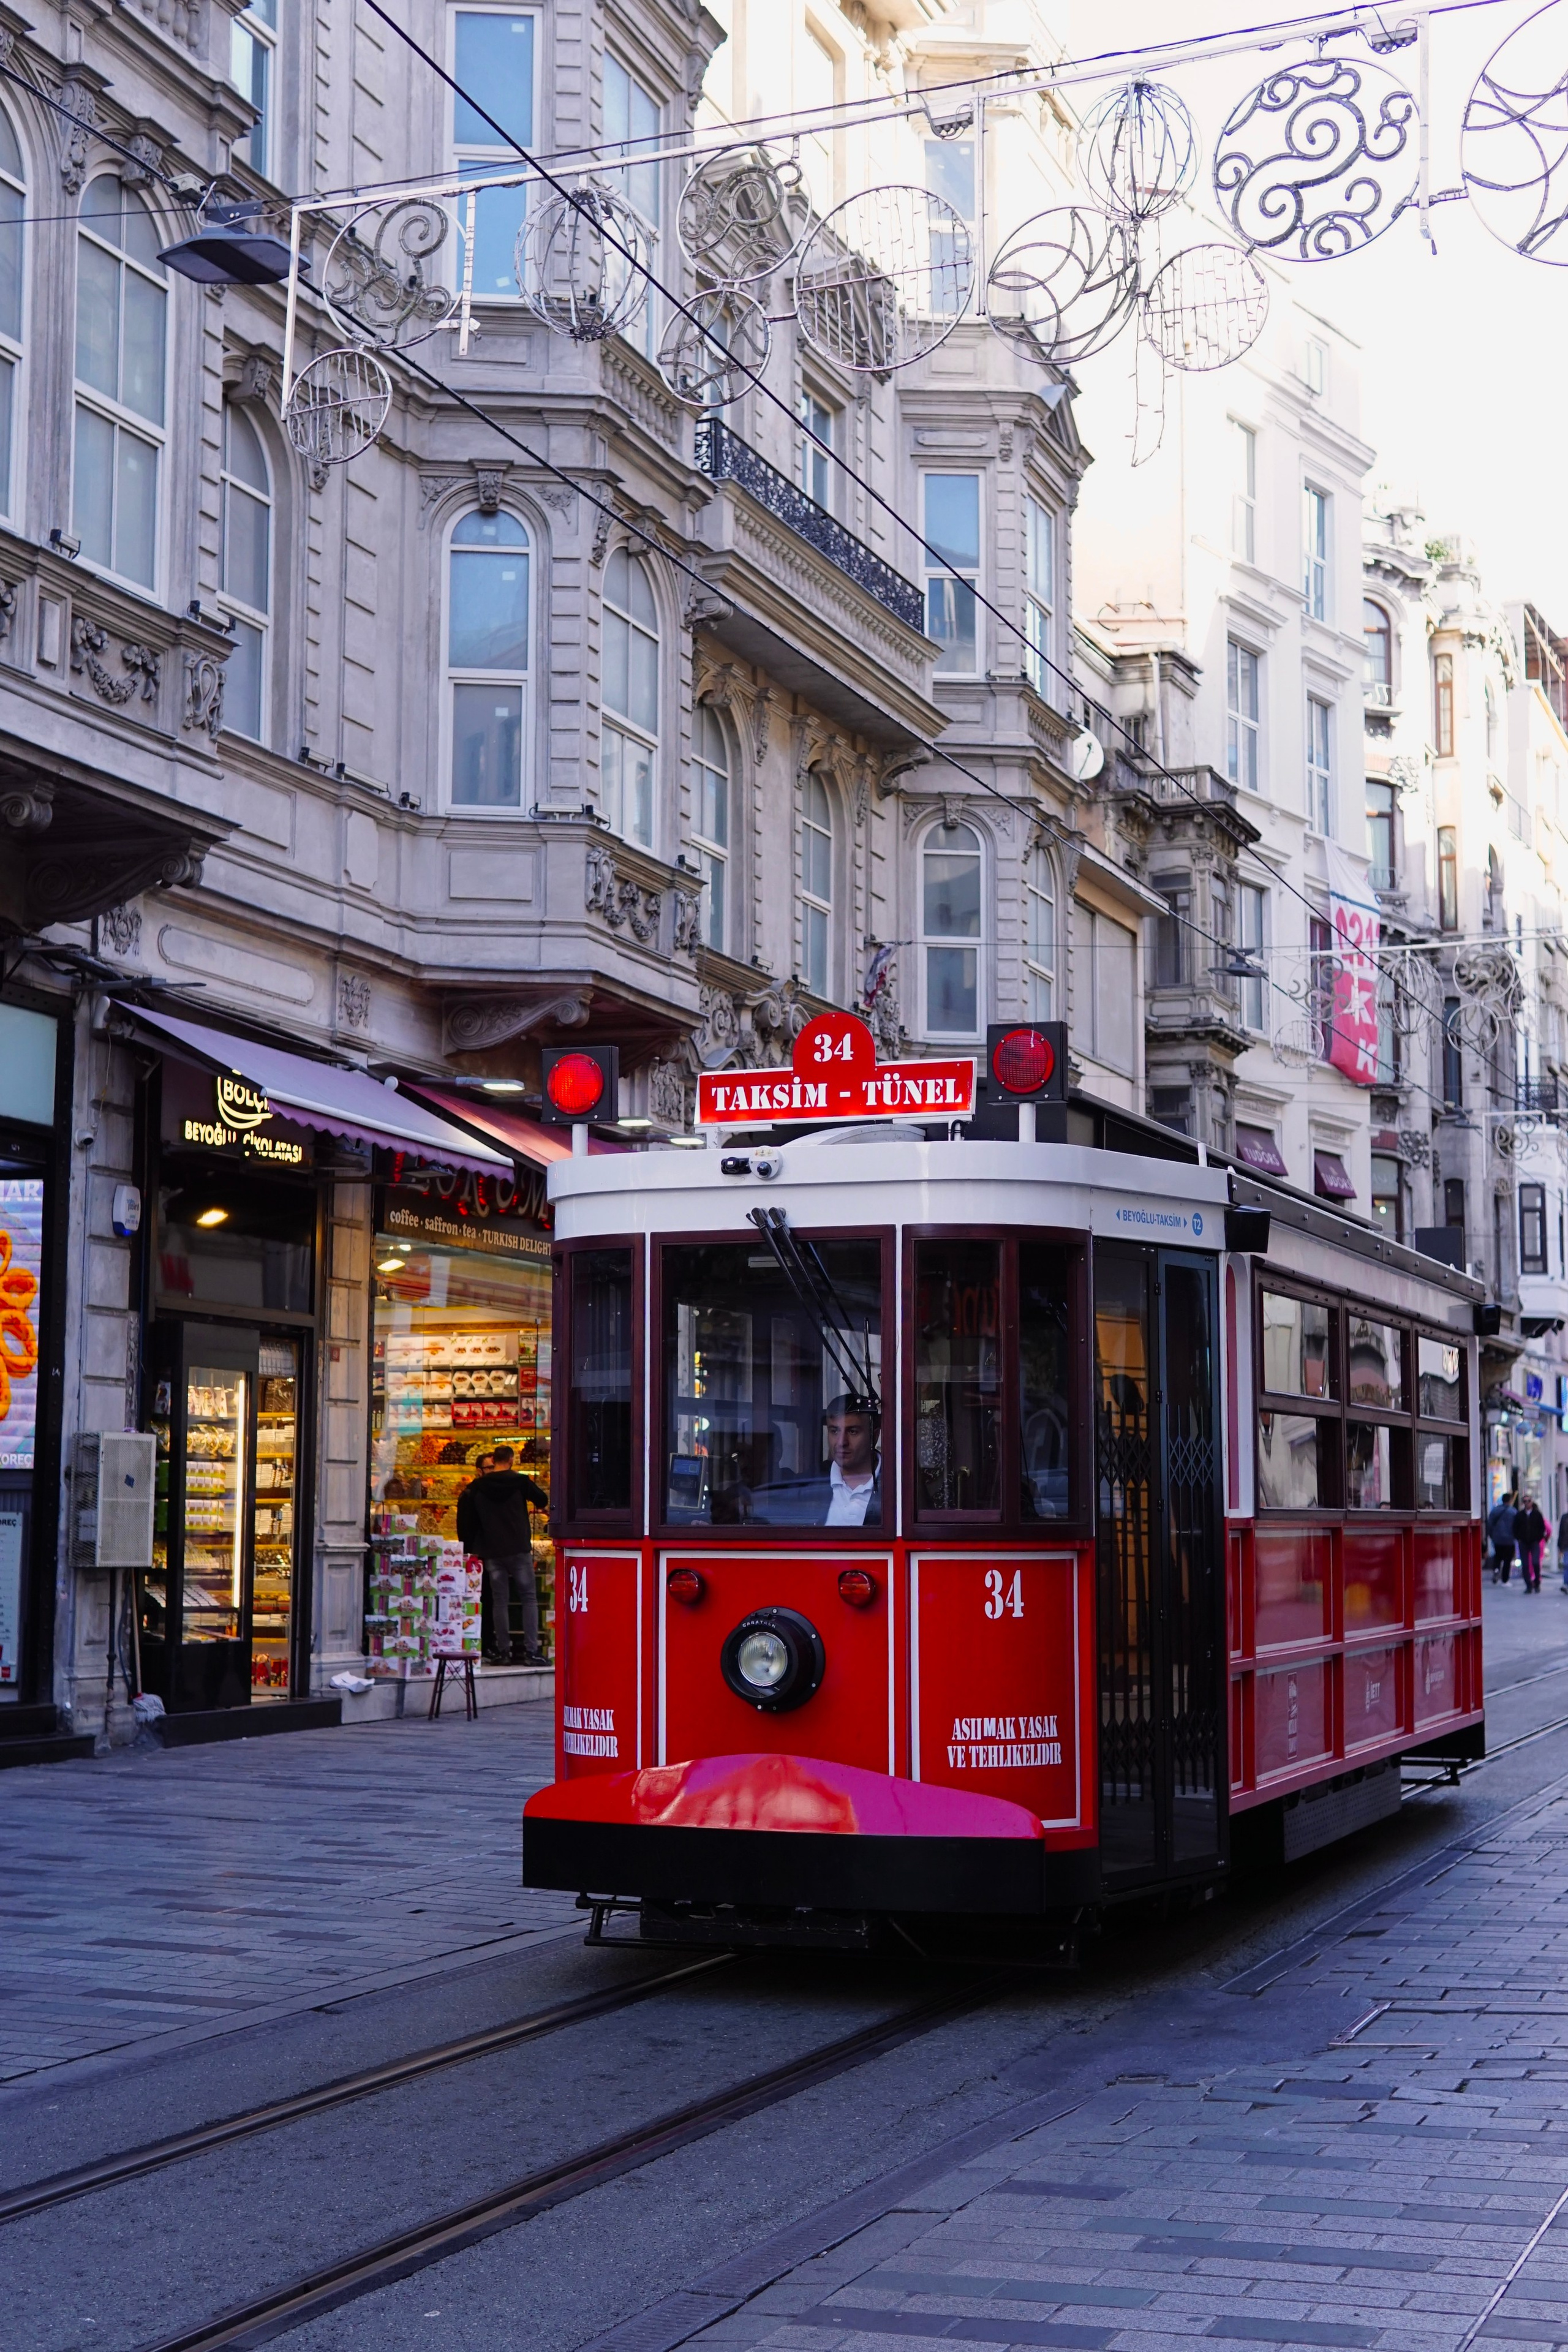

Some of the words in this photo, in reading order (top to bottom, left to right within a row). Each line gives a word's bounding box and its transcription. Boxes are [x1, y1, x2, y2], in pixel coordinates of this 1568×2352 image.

[813, 1033, 853, 1062] 34
[711, 1076, 827, 1111] TAKSİM
[862, 1073, 962, 1106] TÜNEL
[1243, 1147, 1280, 1167] TUDORS
[0, 1180, 42, 1202] AR
[1321, 1172, 1354, 1191] TUDORS
[390, 1208, 419, 1227] coffee
[424, 1216, 458, 1235] saffron
[462, 1223, 476, 1239] tea
[483, 1229, 518, 1250] TURKISH
[1123, 1208, 1181, 1227] BEYOĞLU-TAKSİM
[1193, 1218, 1201, 1230] T2
[0, 1453, 32, 1466] OREÇ
[570, 1566, 589, 1613] 34
[984, 1569, 1025, 1619] 34
[583, 1708, 614, 1731] YASAK
[1018, 1715, 1058, 1739] YASAK
[946, 1746, 967, 1768] VE
[968, 1742, 1062, 1768] TEHLIKELIDIR
